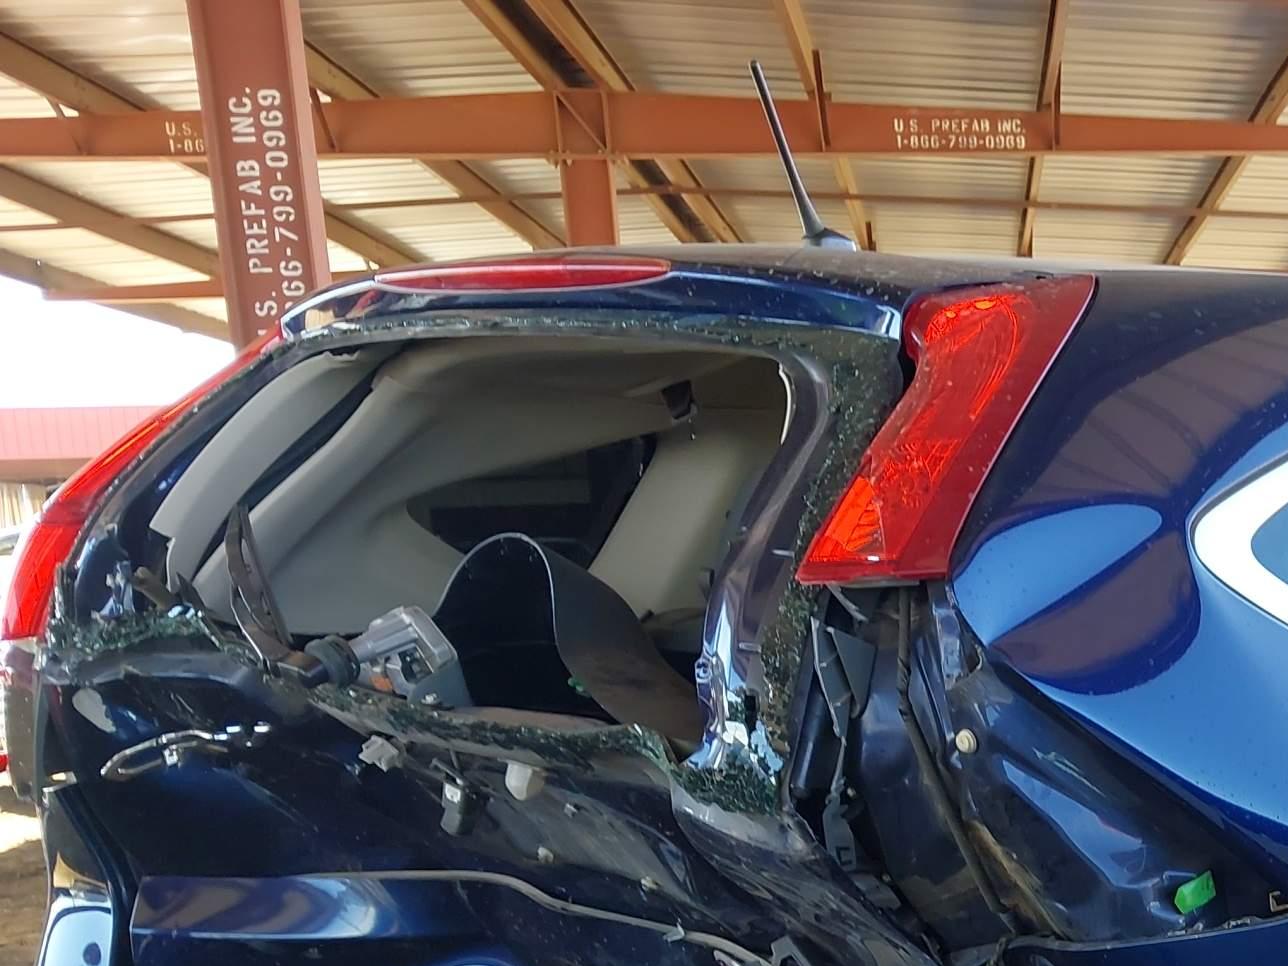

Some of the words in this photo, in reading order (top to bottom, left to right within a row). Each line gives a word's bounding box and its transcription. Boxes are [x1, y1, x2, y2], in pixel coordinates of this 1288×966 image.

[164, 120, 198, 136] U.S.
[228, 87, 256, 143] INC.
[931, 118, 990, 133] PREFAB
[997, 118, 1026, 134] INC.
[236, 159, 273, 274] PREFAB
[257, 88, 305, 311] 66-799-0969
